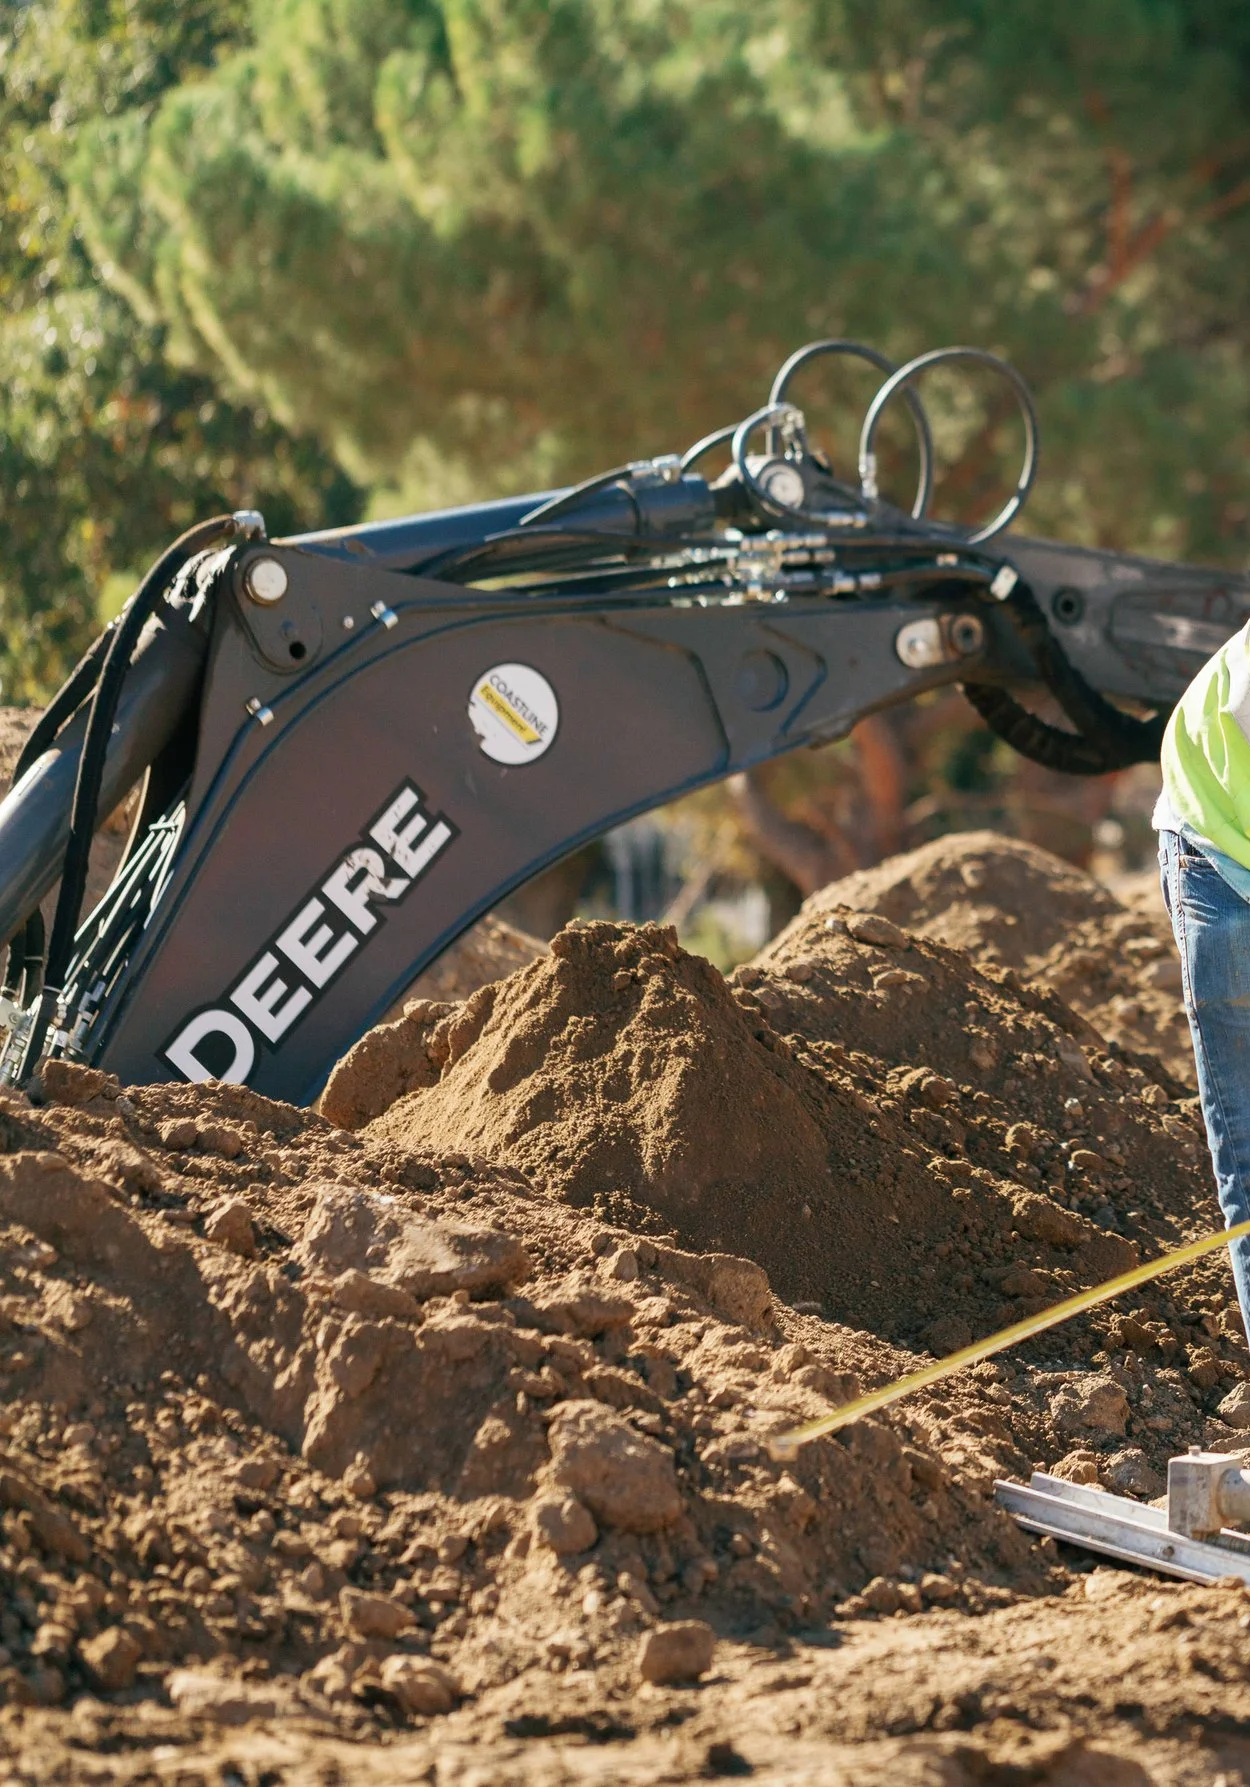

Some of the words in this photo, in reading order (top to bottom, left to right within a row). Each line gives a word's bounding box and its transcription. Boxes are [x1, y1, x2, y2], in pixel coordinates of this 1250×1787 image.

[480, 684, 527, 733] Equipment
[489, 674, 548, 736] COASTLINE
[165, 786, 452, 1084] DEERE
